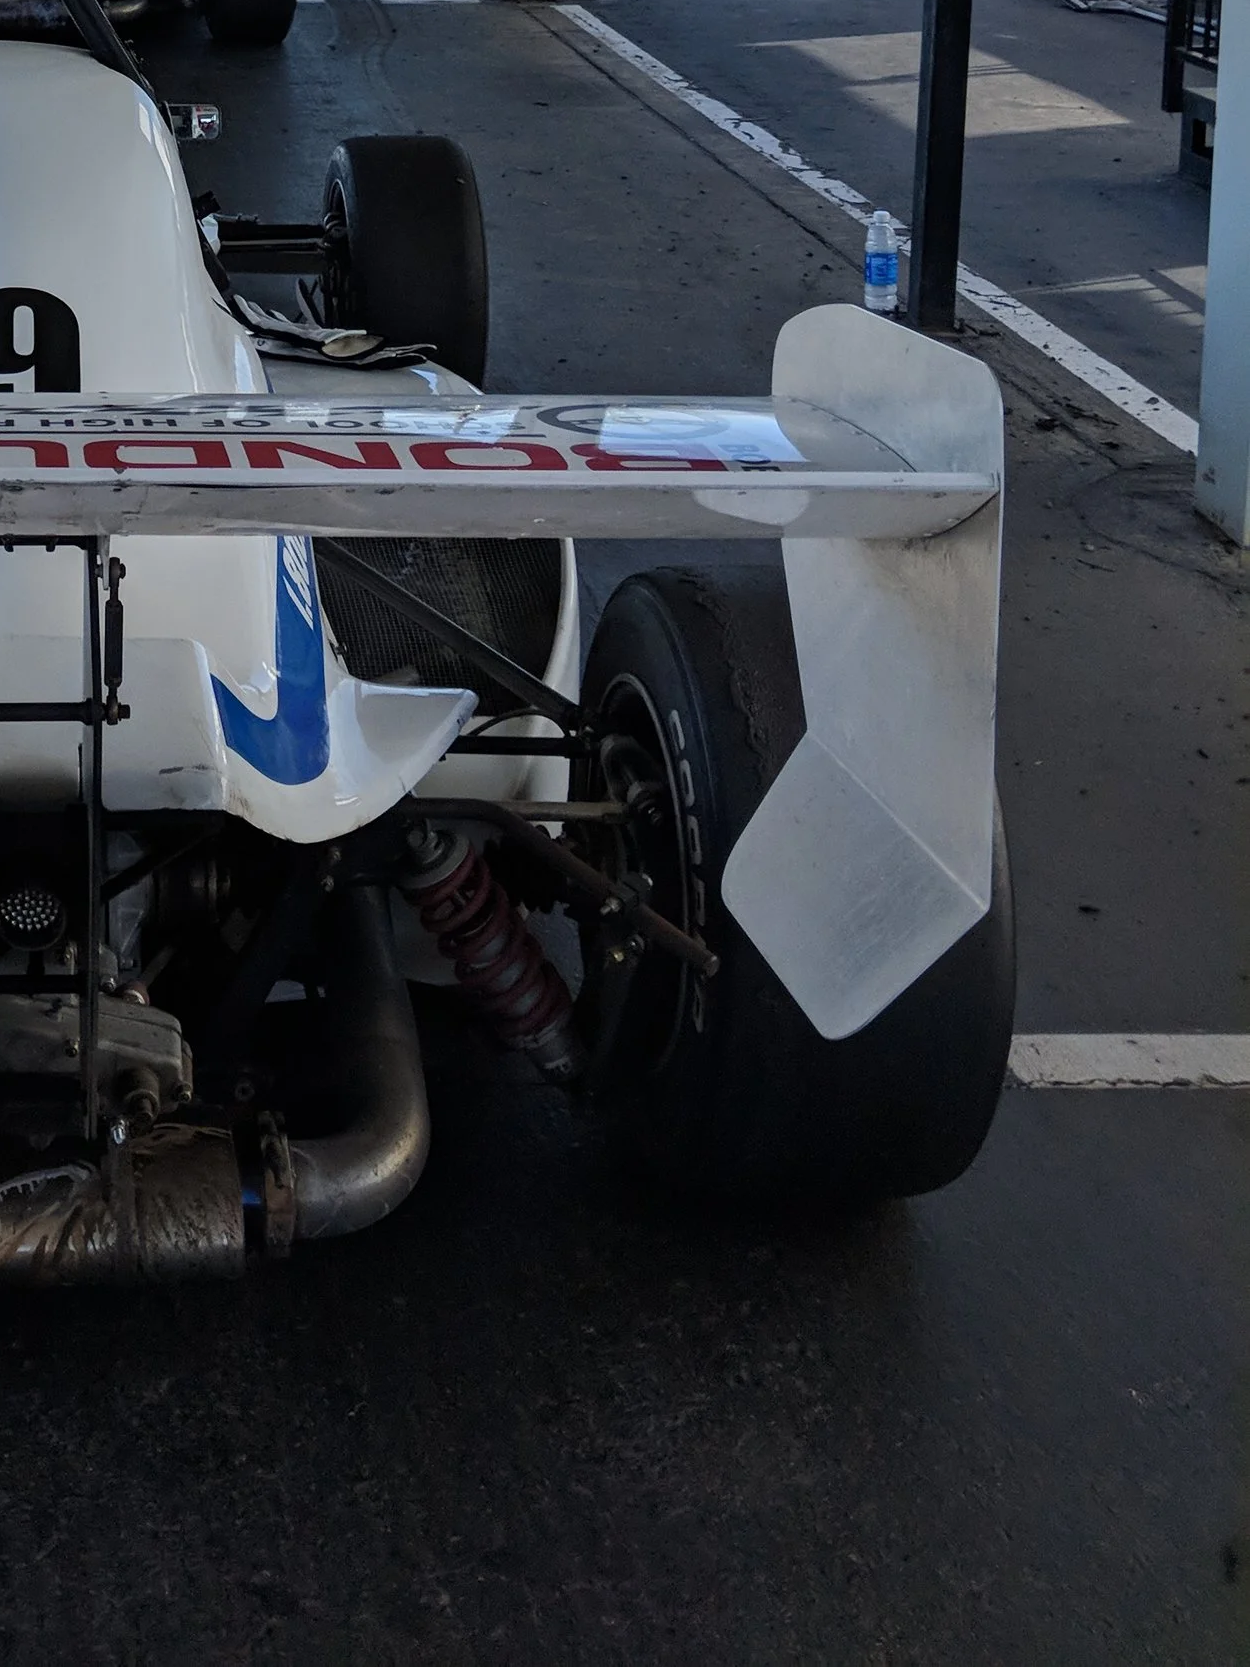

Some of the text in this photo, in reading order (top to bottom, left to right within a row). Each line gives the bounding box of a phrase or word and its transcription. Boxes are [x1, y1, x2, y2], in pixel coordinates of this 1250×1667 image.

[40, 417, 178, 430] HIGH
[201, 418, 271, 430] OF
[293, 419, 526, 431] SCHOOL
